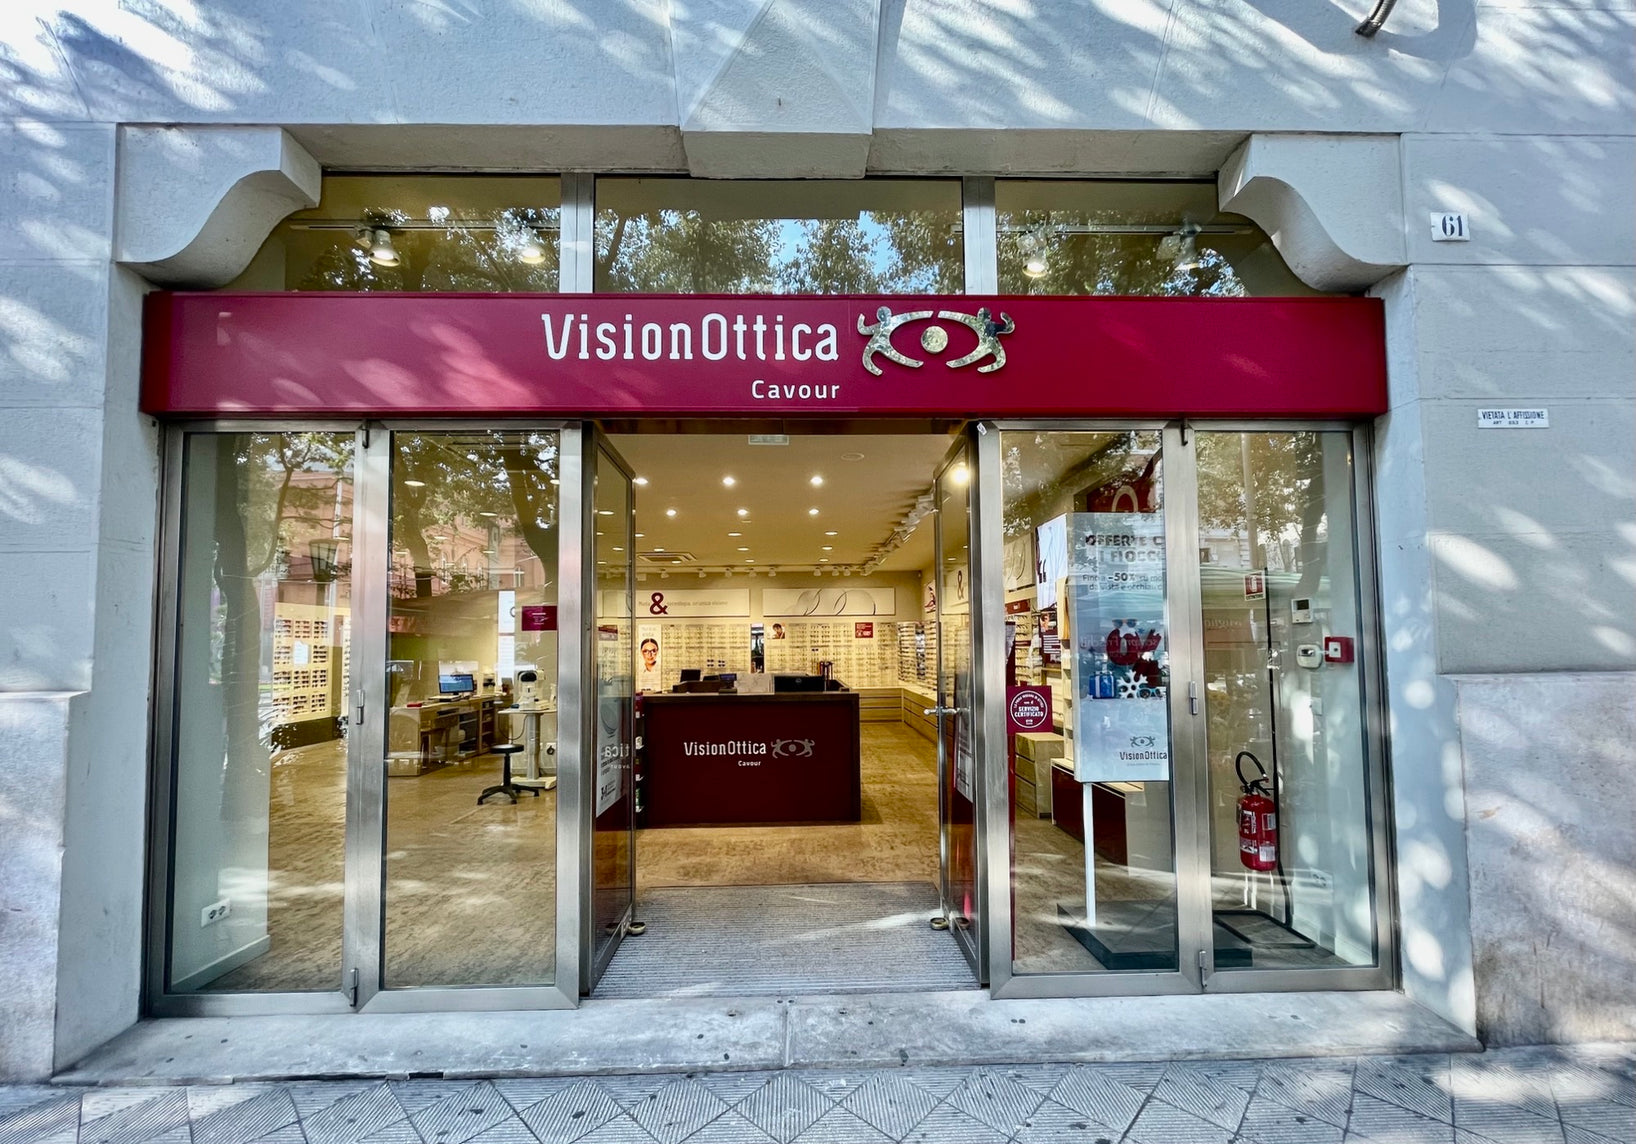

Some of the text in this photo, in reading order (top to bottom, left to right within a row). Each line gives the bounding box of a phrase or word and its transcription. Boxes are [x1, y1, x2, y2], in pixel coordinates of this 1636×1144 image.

[1441, 215, 1463, 237] 61
[541, 312, 840, 362] VisionOttica
[751, 379, 841, 399] Cavour
[1481, 410, 1505, 420] VIETATA
[684, 740, 767, 756] VisionOttica
[1119, 750, 1168, 761] VisionOttica
